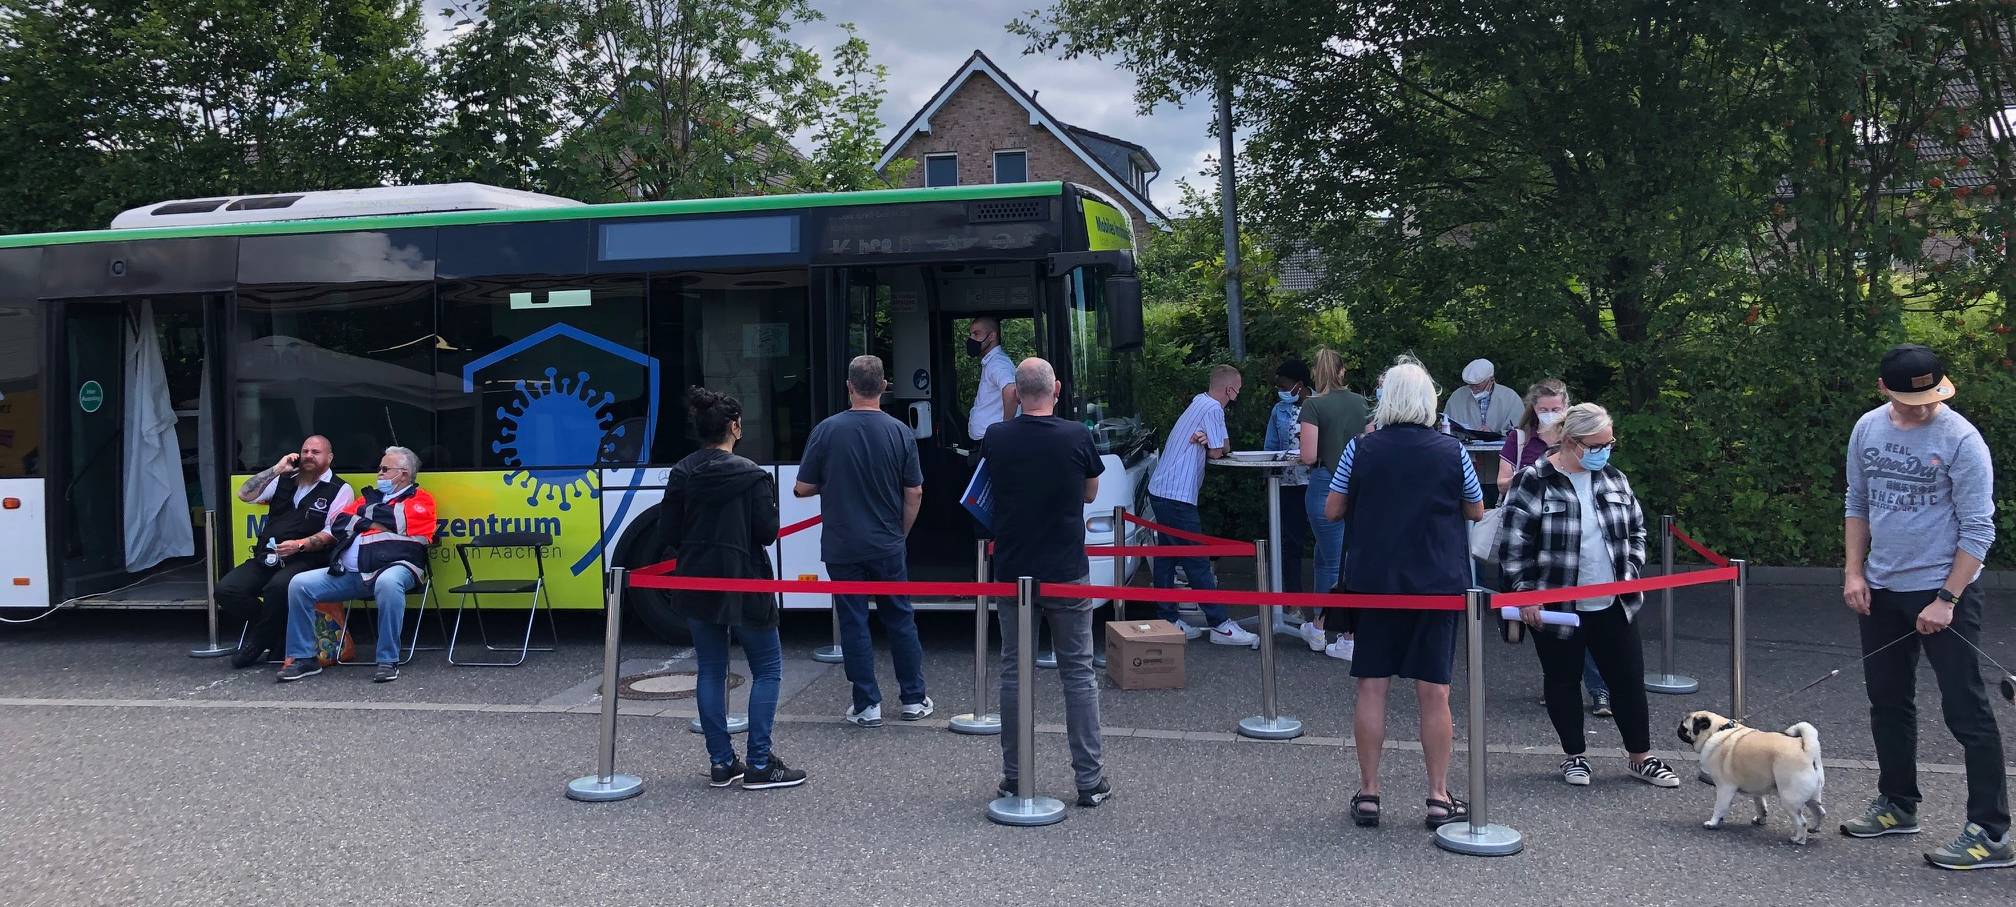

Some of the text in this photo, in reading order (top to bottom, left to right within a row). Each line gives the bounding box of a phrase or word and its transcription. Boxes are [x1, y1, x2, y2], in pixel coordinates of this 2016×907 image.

[1885, 442, 1912, 456] REAL
[1876, 812, 1898, 829] N
[1966, 844, 1991, 861] N
